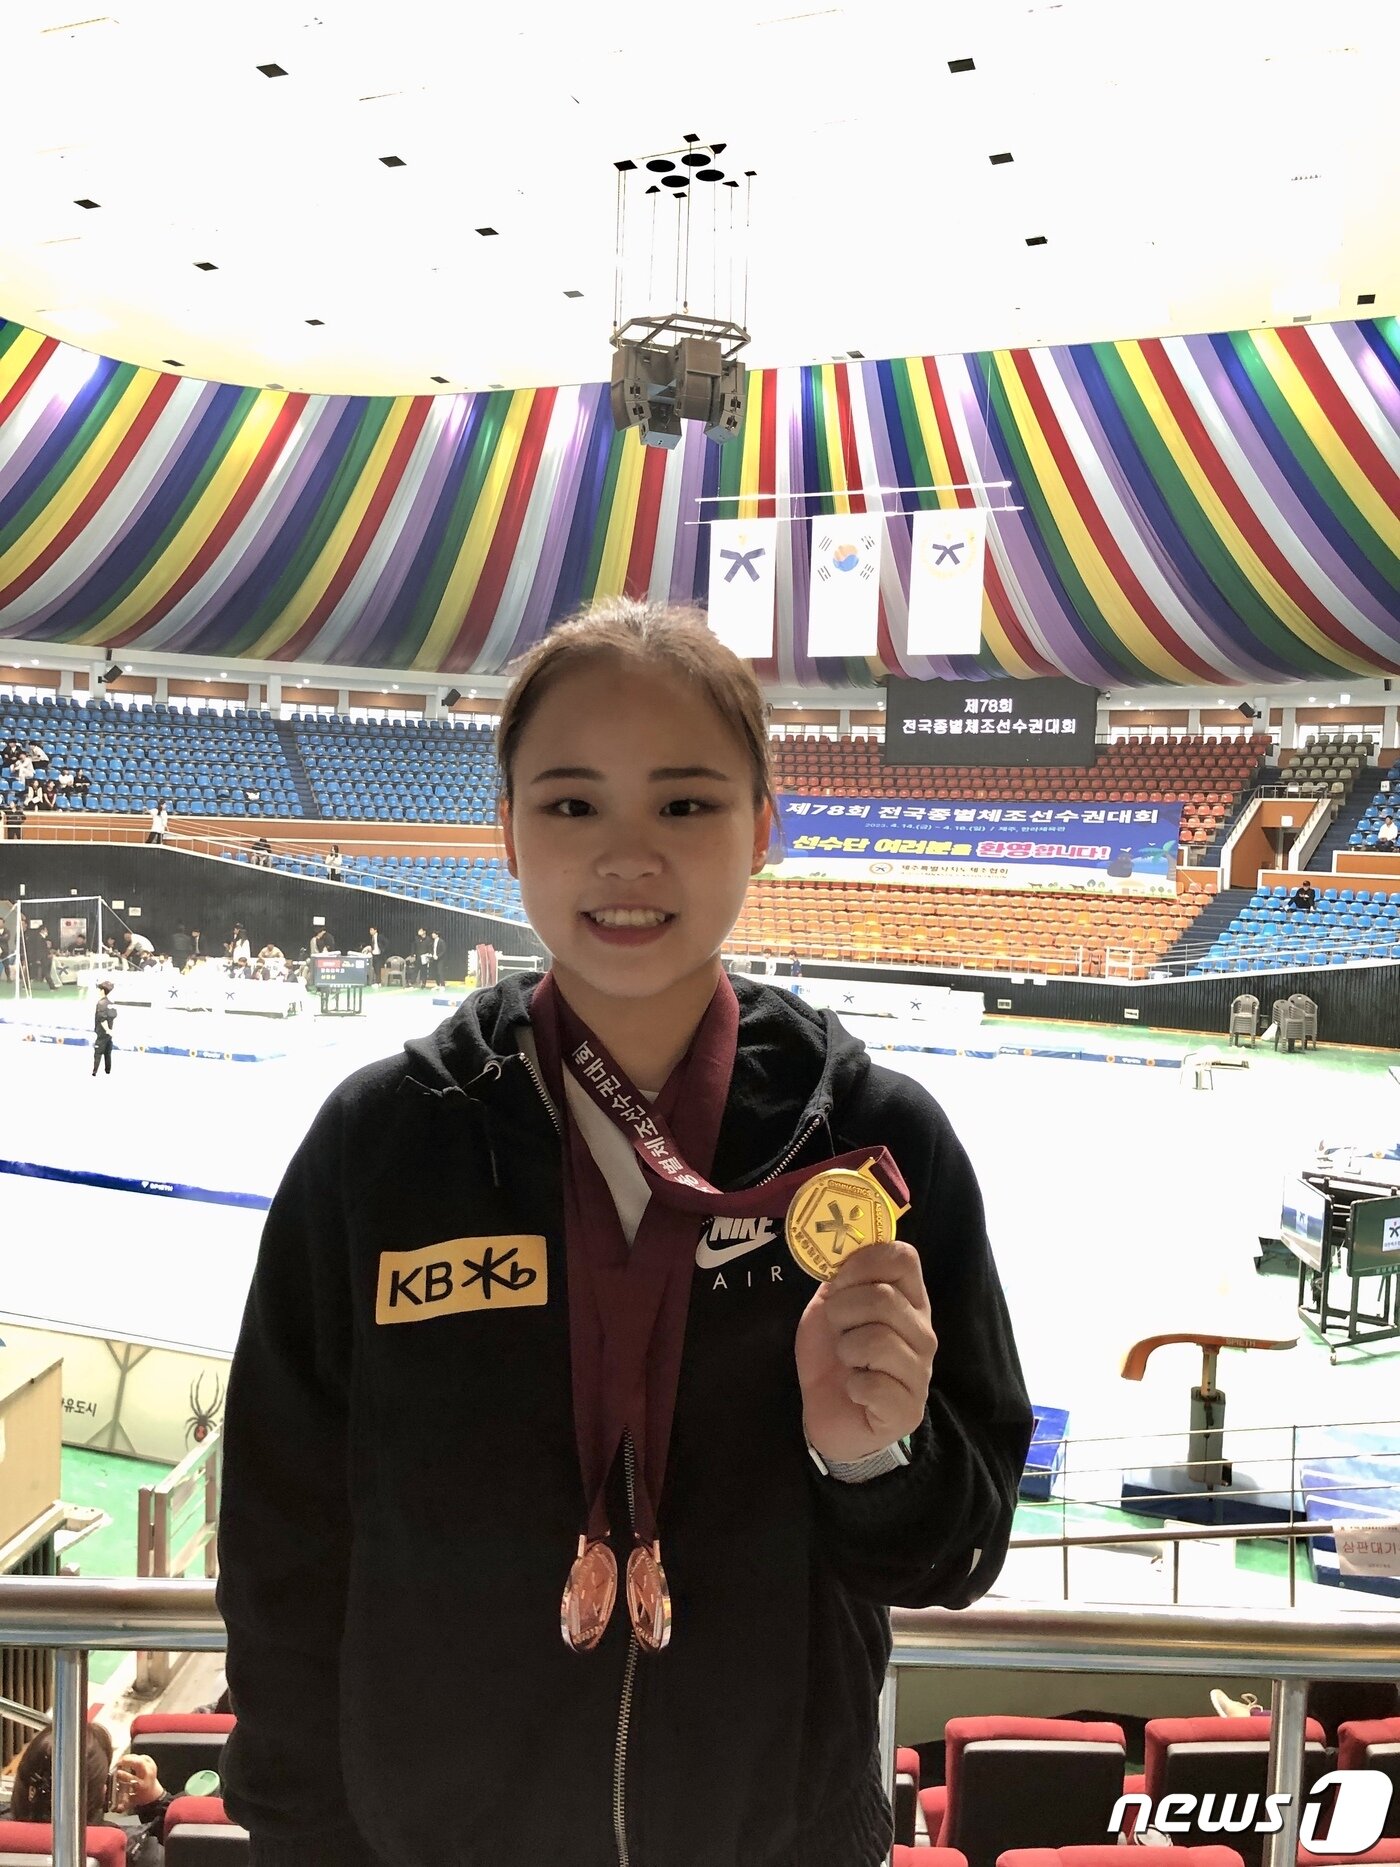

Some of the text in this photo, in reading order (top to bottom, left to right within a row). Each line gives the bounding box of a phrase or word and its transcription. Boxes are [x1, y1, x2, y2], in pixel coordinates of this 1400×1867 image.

[964, 698, 1013, 713] 제78회
[902, 718, 1076, 734] 전국종별체조선수권대회
[785, 802, 1159, 824] 제78회 전국종별체조선수권대회
[793, 835, 1110, 859] 선수단 여러분을 환영합니다!
[710, 1216, 774, 1241] NIKE
[712, 1265, 783, 1290] AIR
[1344, 1541, 1400, 1554] 심판대기
